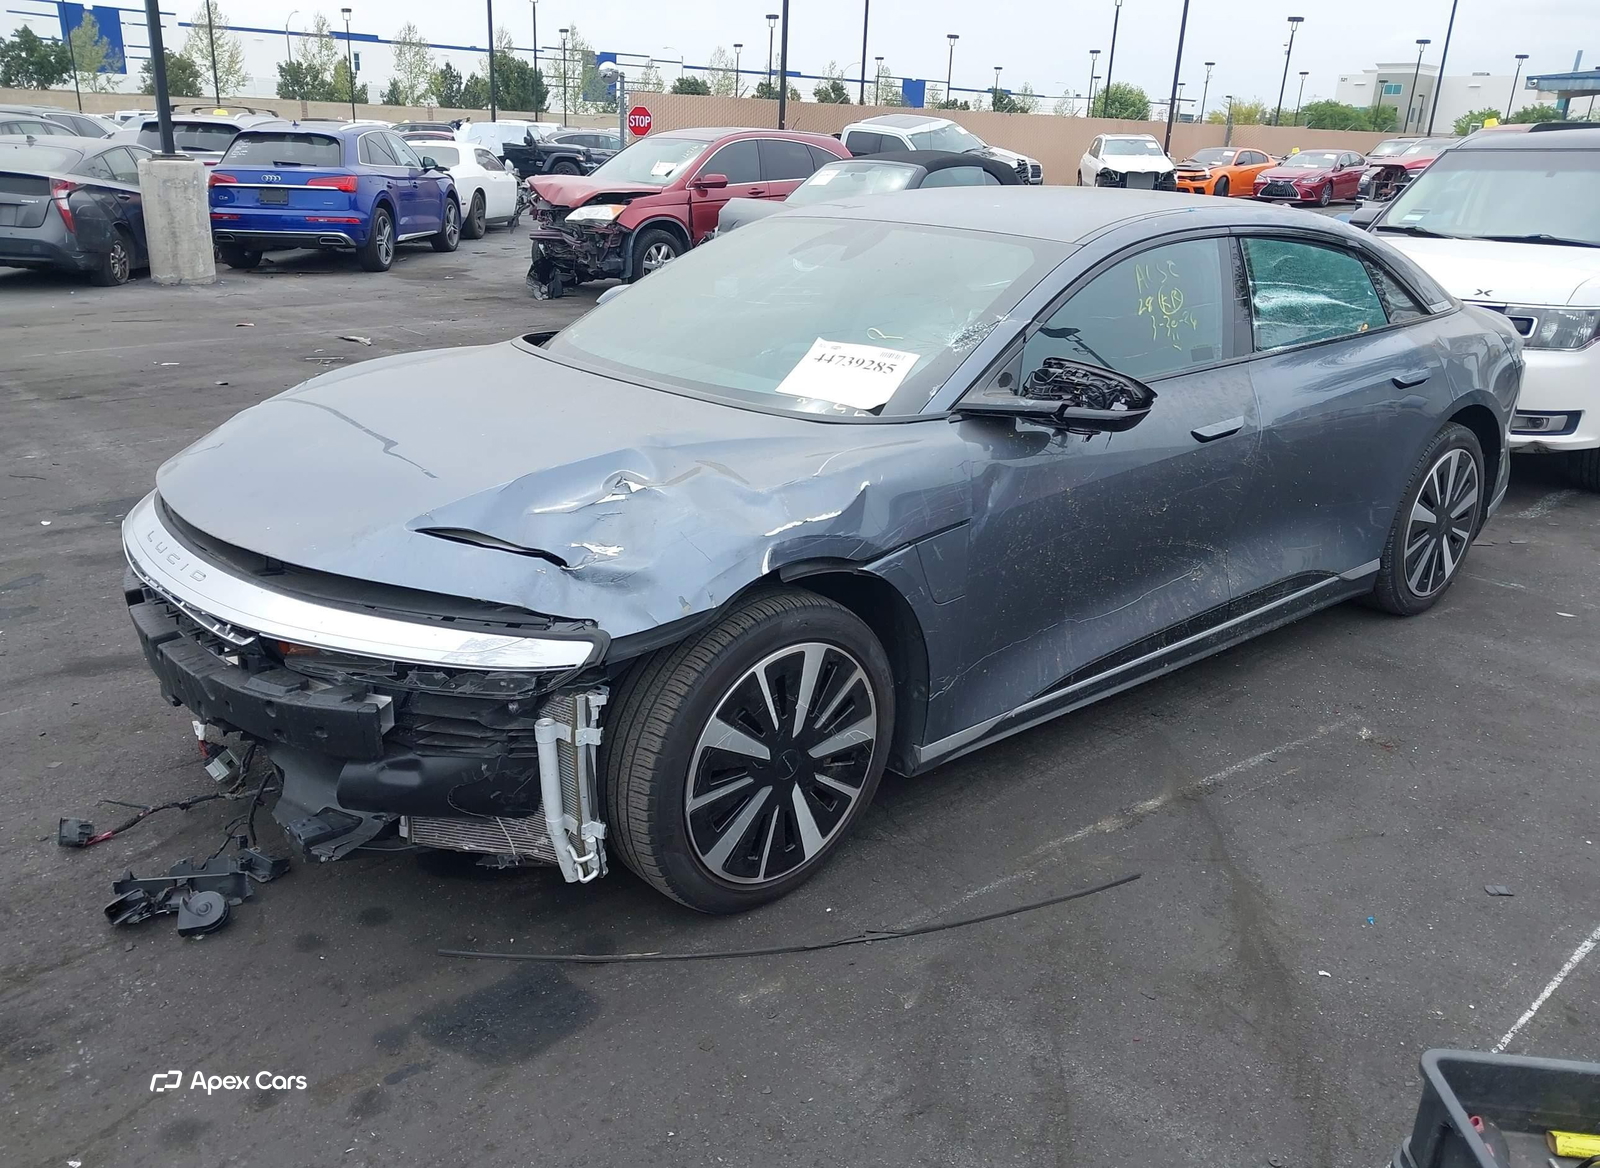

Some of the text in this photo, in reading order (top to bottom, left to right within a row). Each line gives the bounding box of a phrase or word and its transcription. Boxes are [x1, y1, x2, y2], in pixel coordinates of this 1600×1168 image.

[629, 115, 651, 128] STOP
[814, 353, 898, 374] 44739285
[146, 530, 207, 582] LUCID
